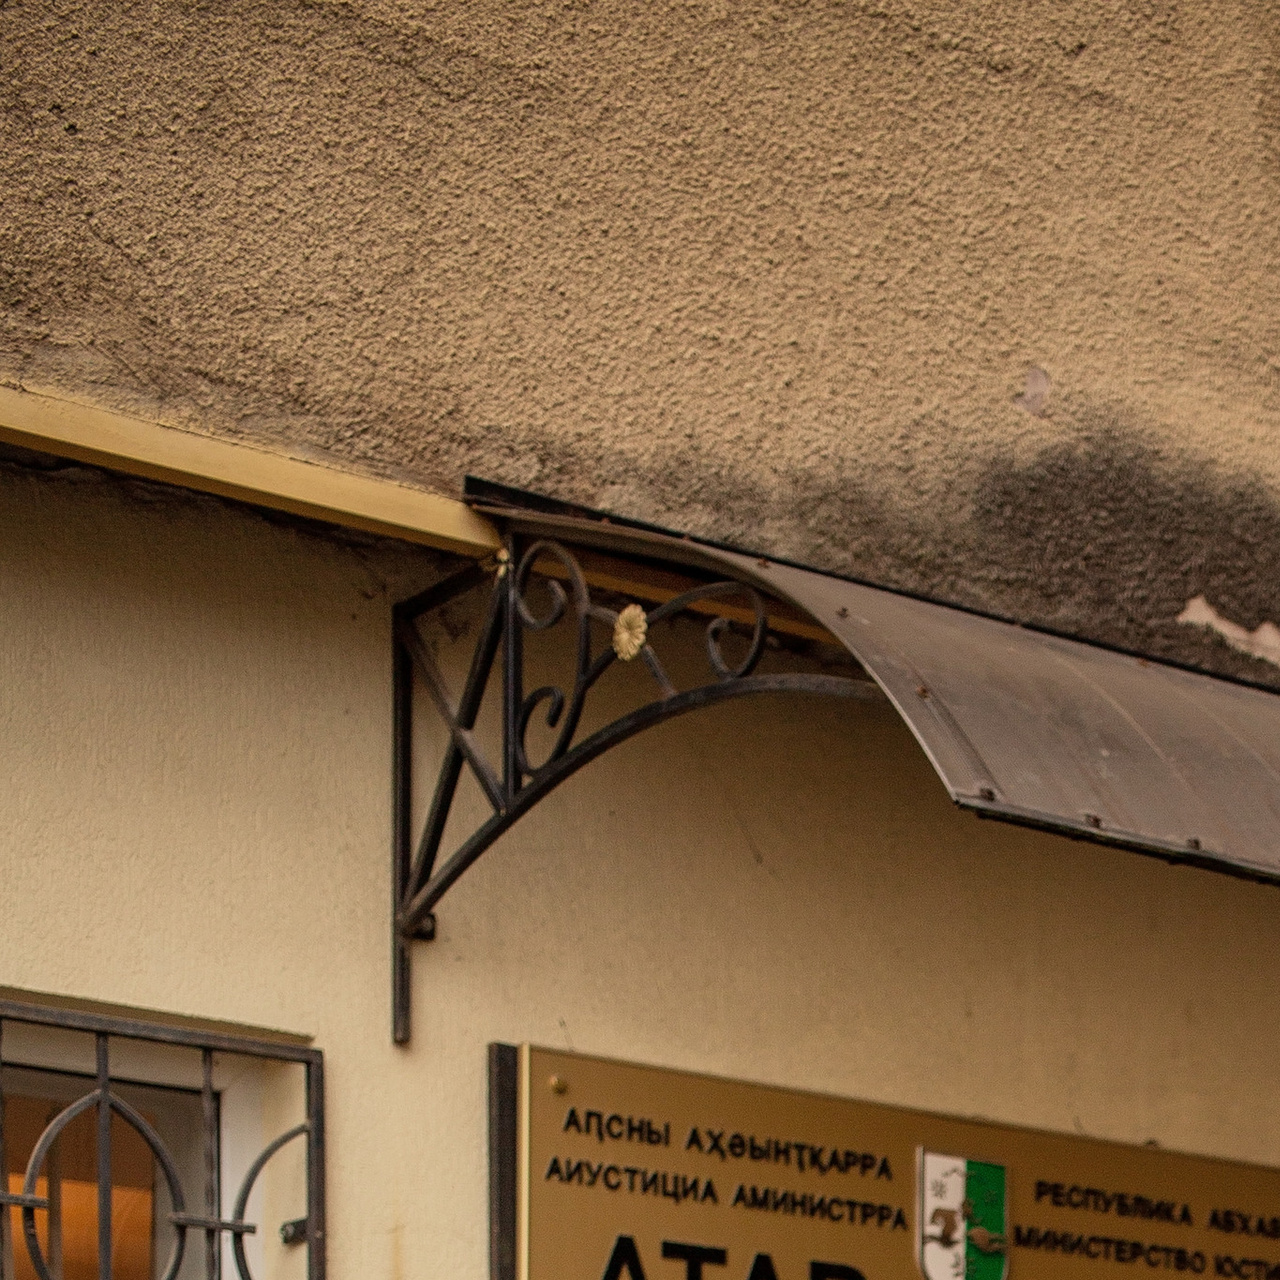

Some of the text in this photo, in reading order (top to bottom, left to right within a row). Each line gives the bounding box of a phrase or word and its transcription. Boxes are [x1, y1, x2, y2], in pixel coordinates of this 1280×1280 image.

[545, 1157, 908, 1230] АИУСТИЦИА АМИНИСТРРА
[1035, 1180, 1193, 1227] РЕСПУБЛИКА
[1014, 1225, 1206, 1274] МИНИСТЕРСТВО
